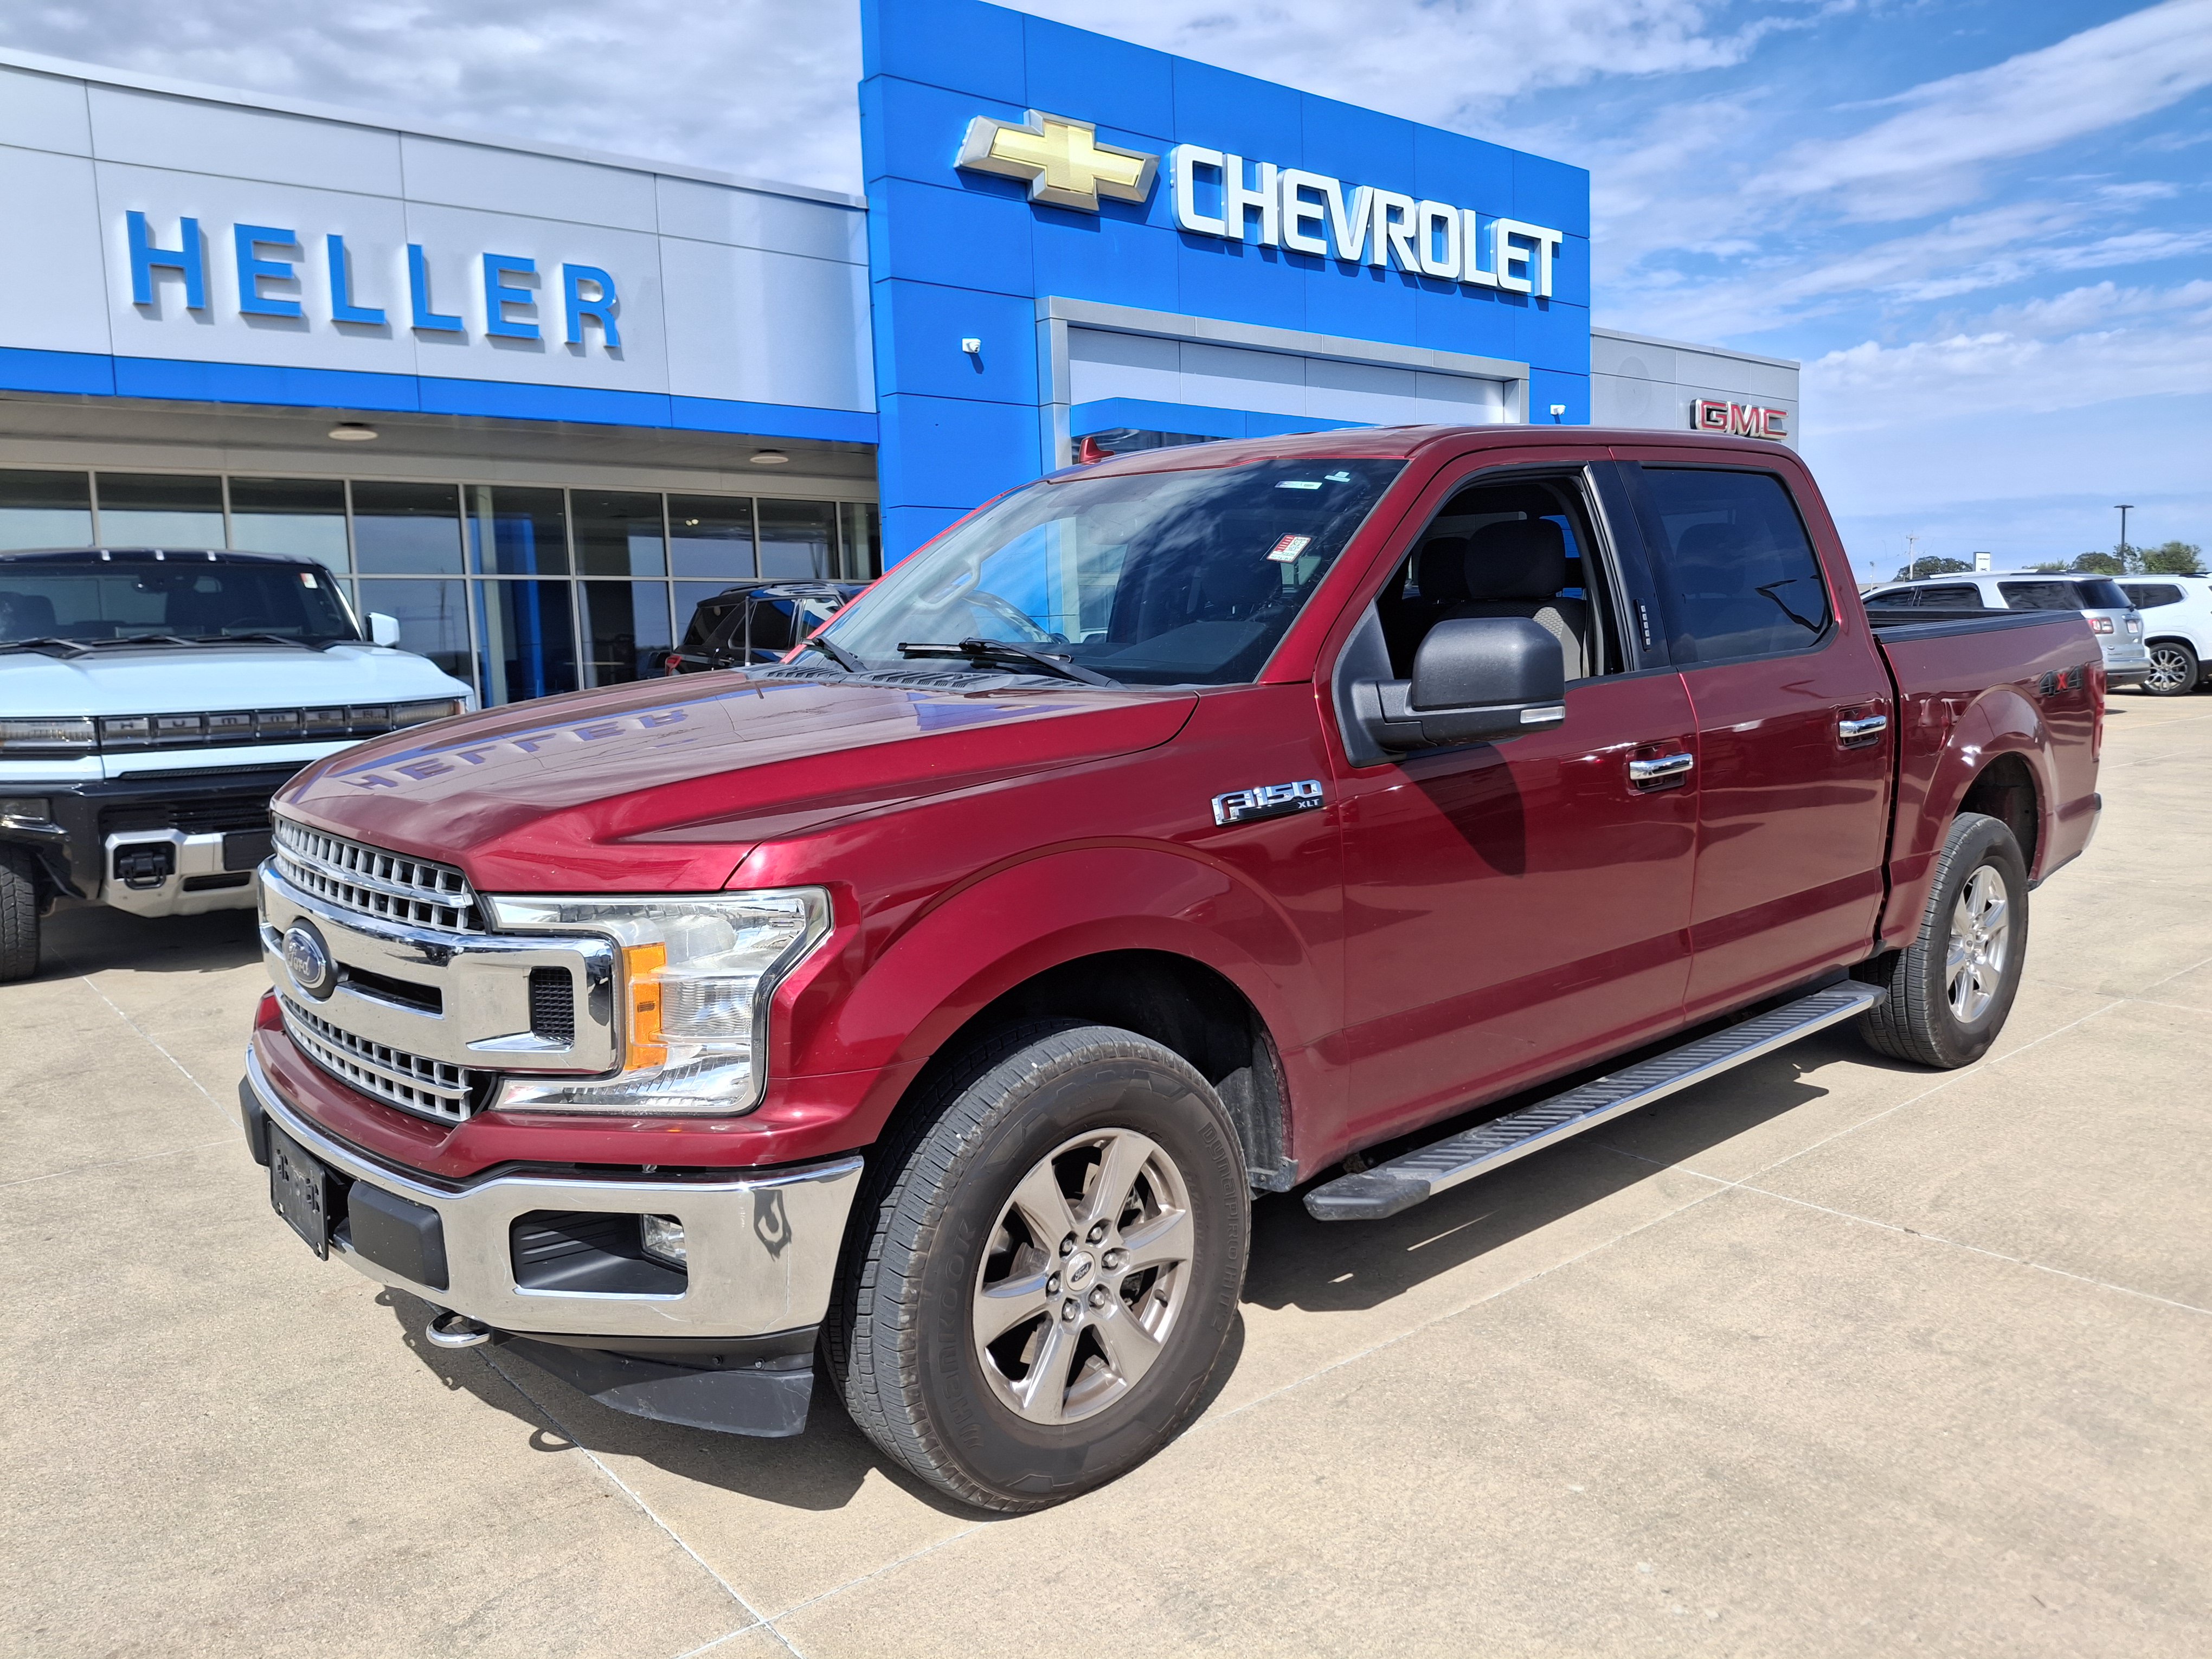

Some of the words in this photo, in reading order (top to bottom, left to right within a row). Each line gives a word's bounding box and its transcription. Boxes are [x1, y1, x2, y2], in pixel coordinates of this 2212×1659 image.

[1171, 143, 1563, 297] CHEVROLET
[126, 210, 620, 348] HELLER
[1690, 398, 1788, 440] GMC
[1297, 799, 1320, 809] XLT
[287, 942, 310, 976] Ford
[1075, 1264, 1089, 1281] Ford
